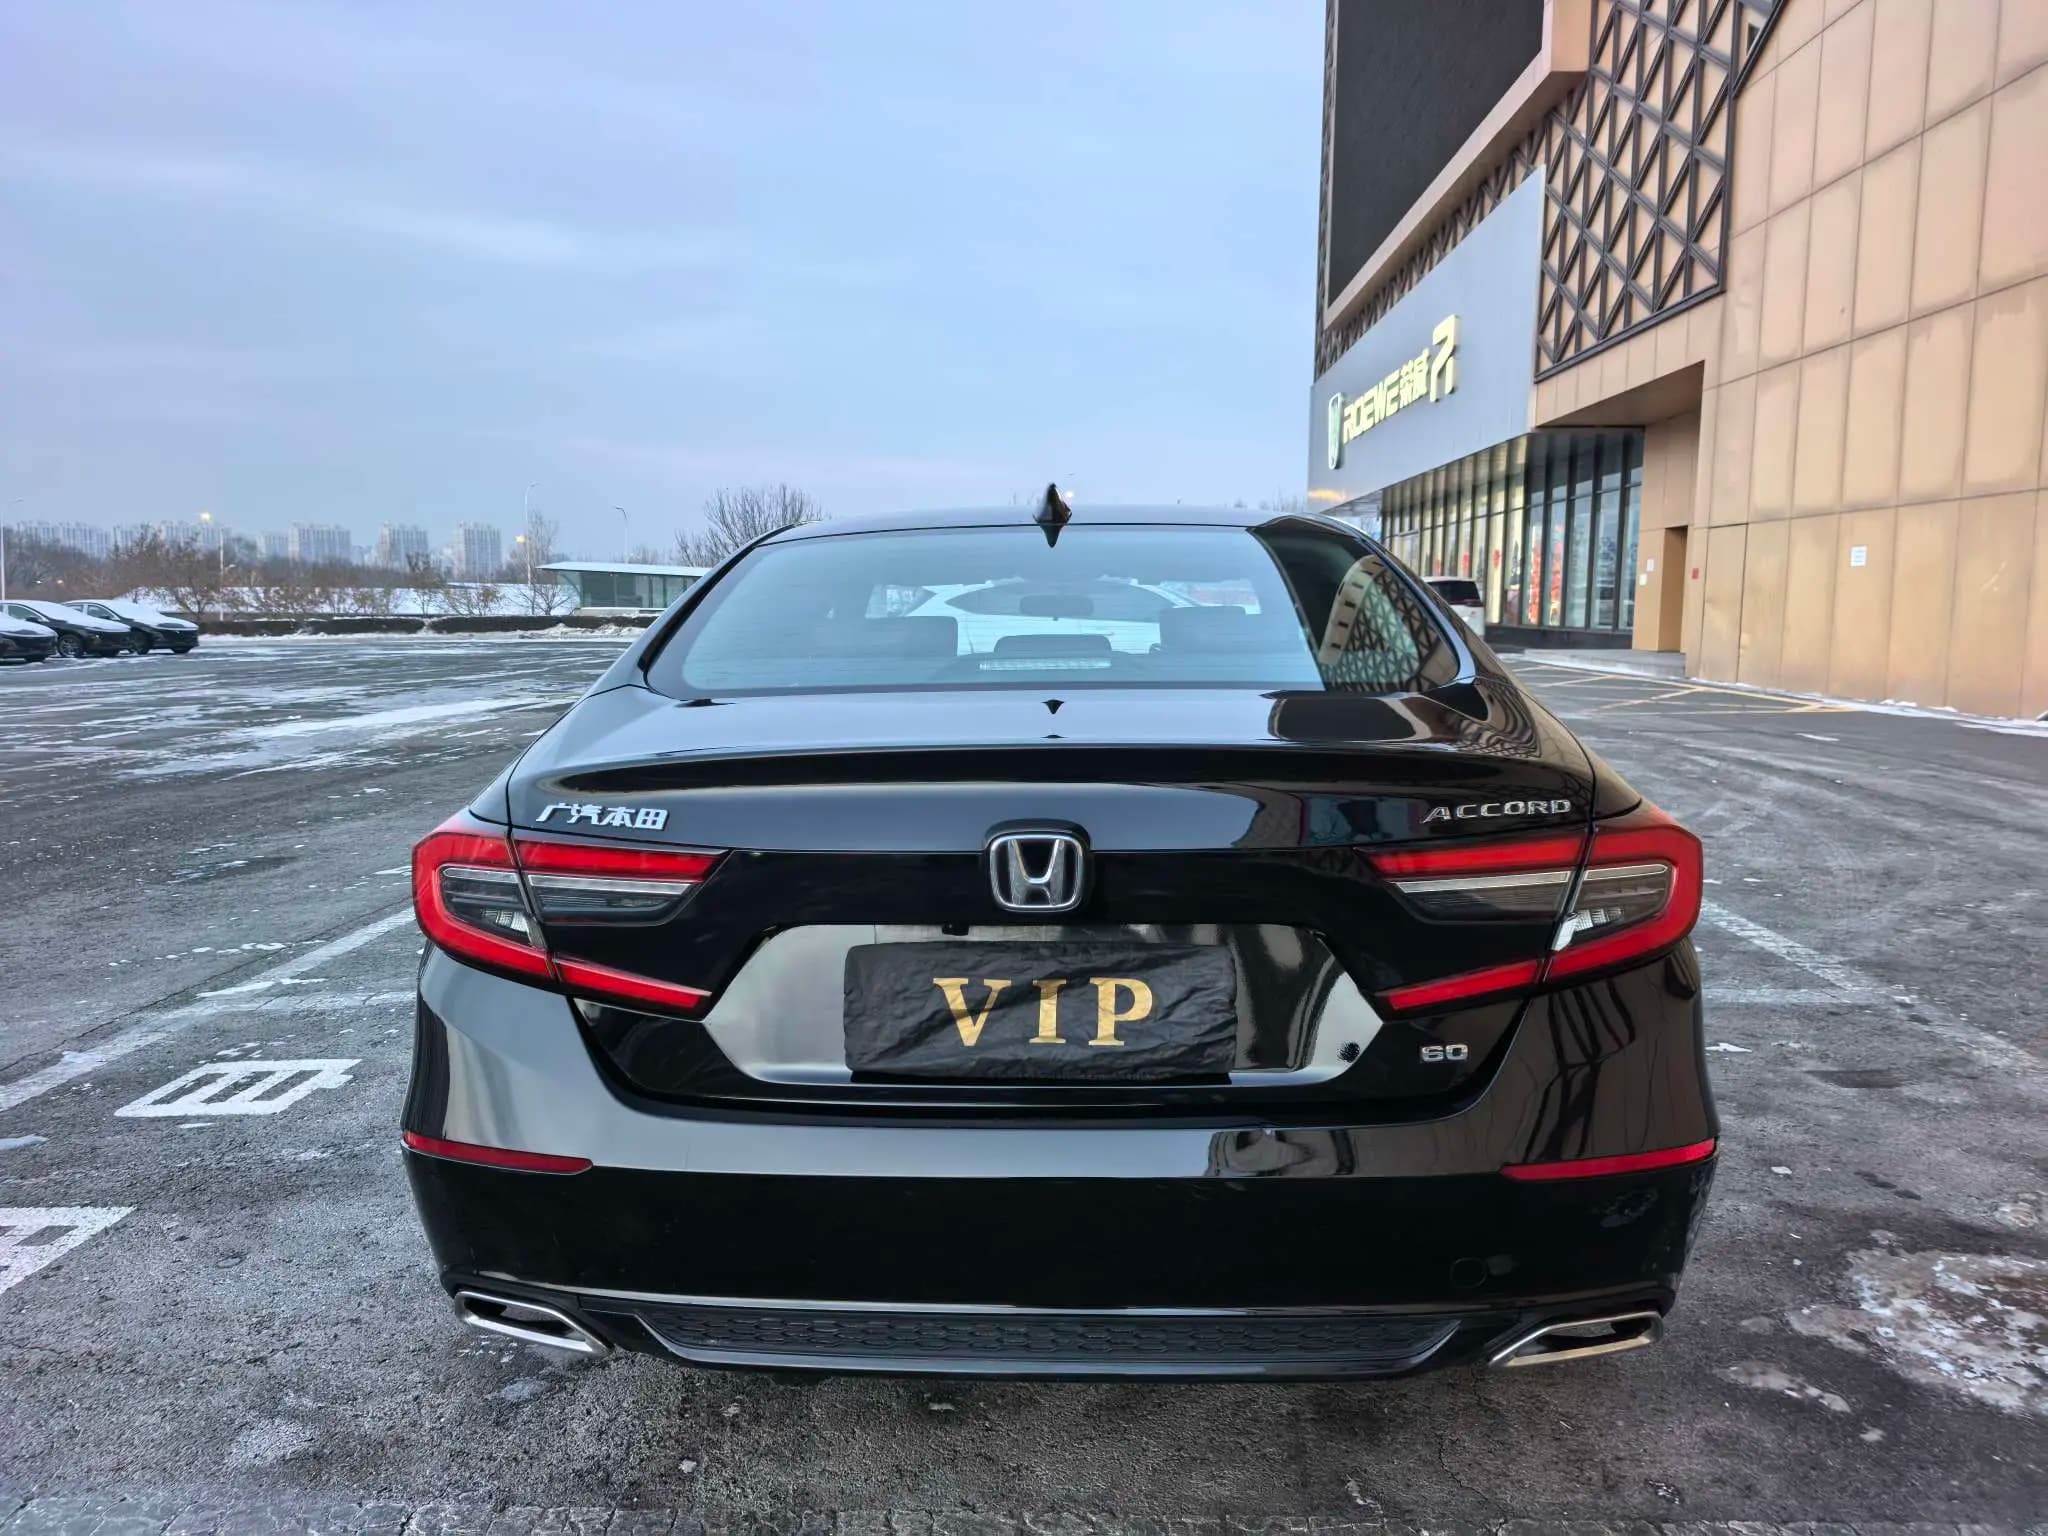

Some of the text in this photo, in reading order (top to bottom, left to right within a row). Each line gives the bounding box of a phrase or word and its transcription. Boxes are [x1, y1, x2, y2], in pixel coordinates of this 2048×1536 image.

[536, 803, 669, 831] 广汽本田
[1422, 799, 1572, 824] ACCORD
[933, 977, 1153, 1047] VIP
